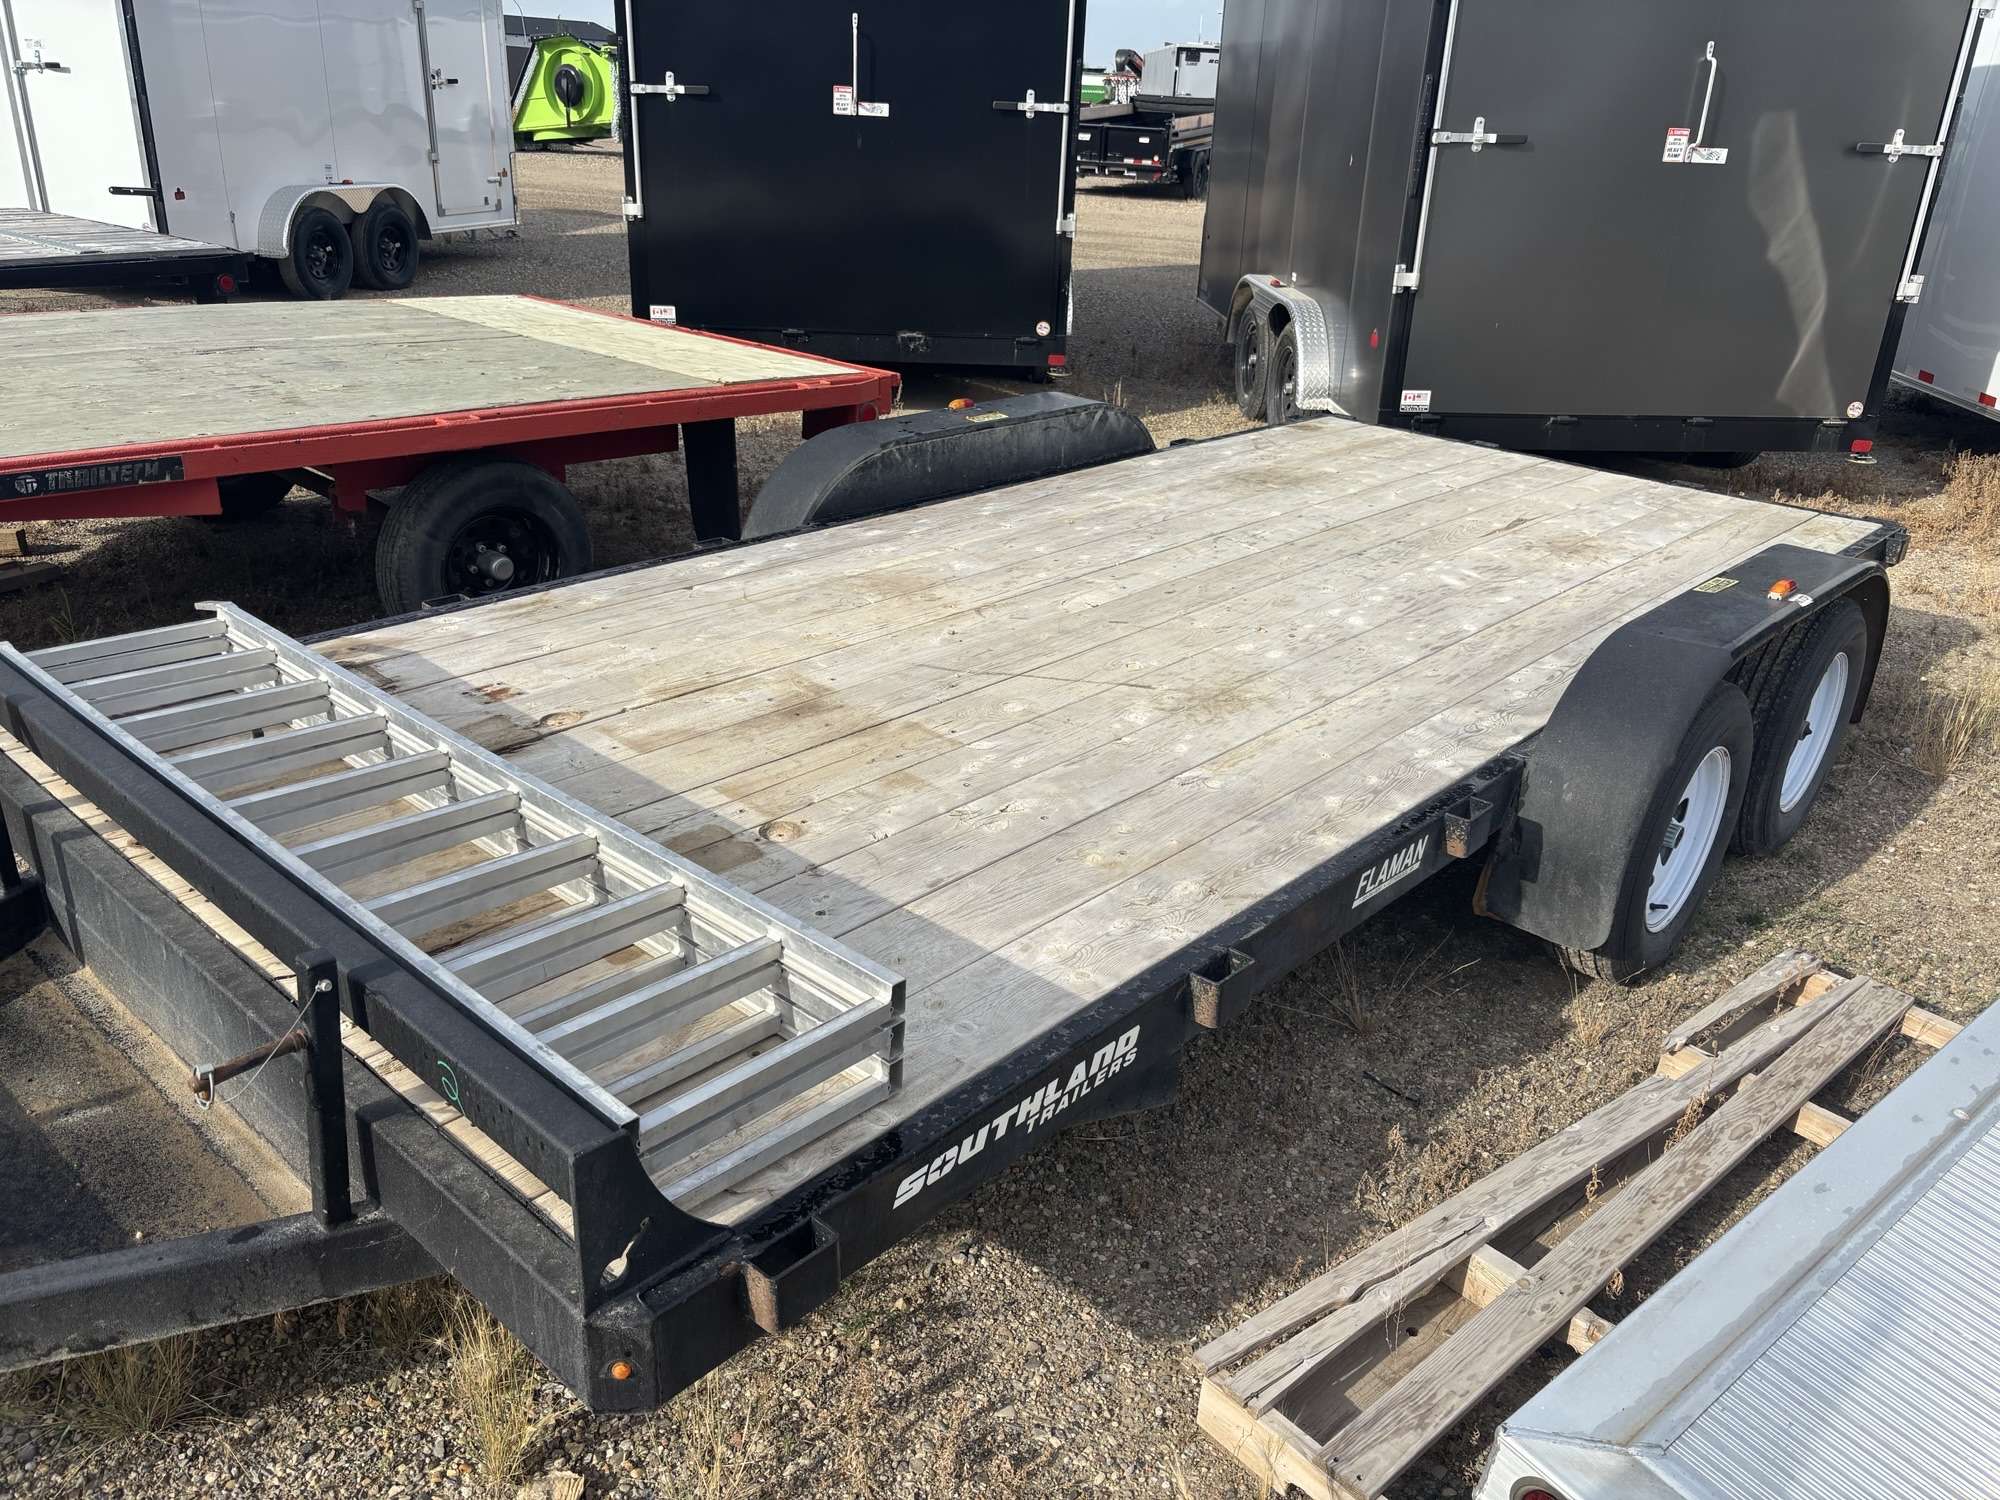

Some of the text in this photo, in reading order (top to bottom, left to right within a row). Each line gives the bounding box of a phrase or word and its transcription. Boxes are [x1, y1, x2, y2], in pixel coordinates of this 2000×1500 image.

[1354, 834, 1429, 900] FLAMAN
[893, 1025, 1140, 1210] SOUTHLAND
[1027, 1048, 1138, 1134] TRAILERS
